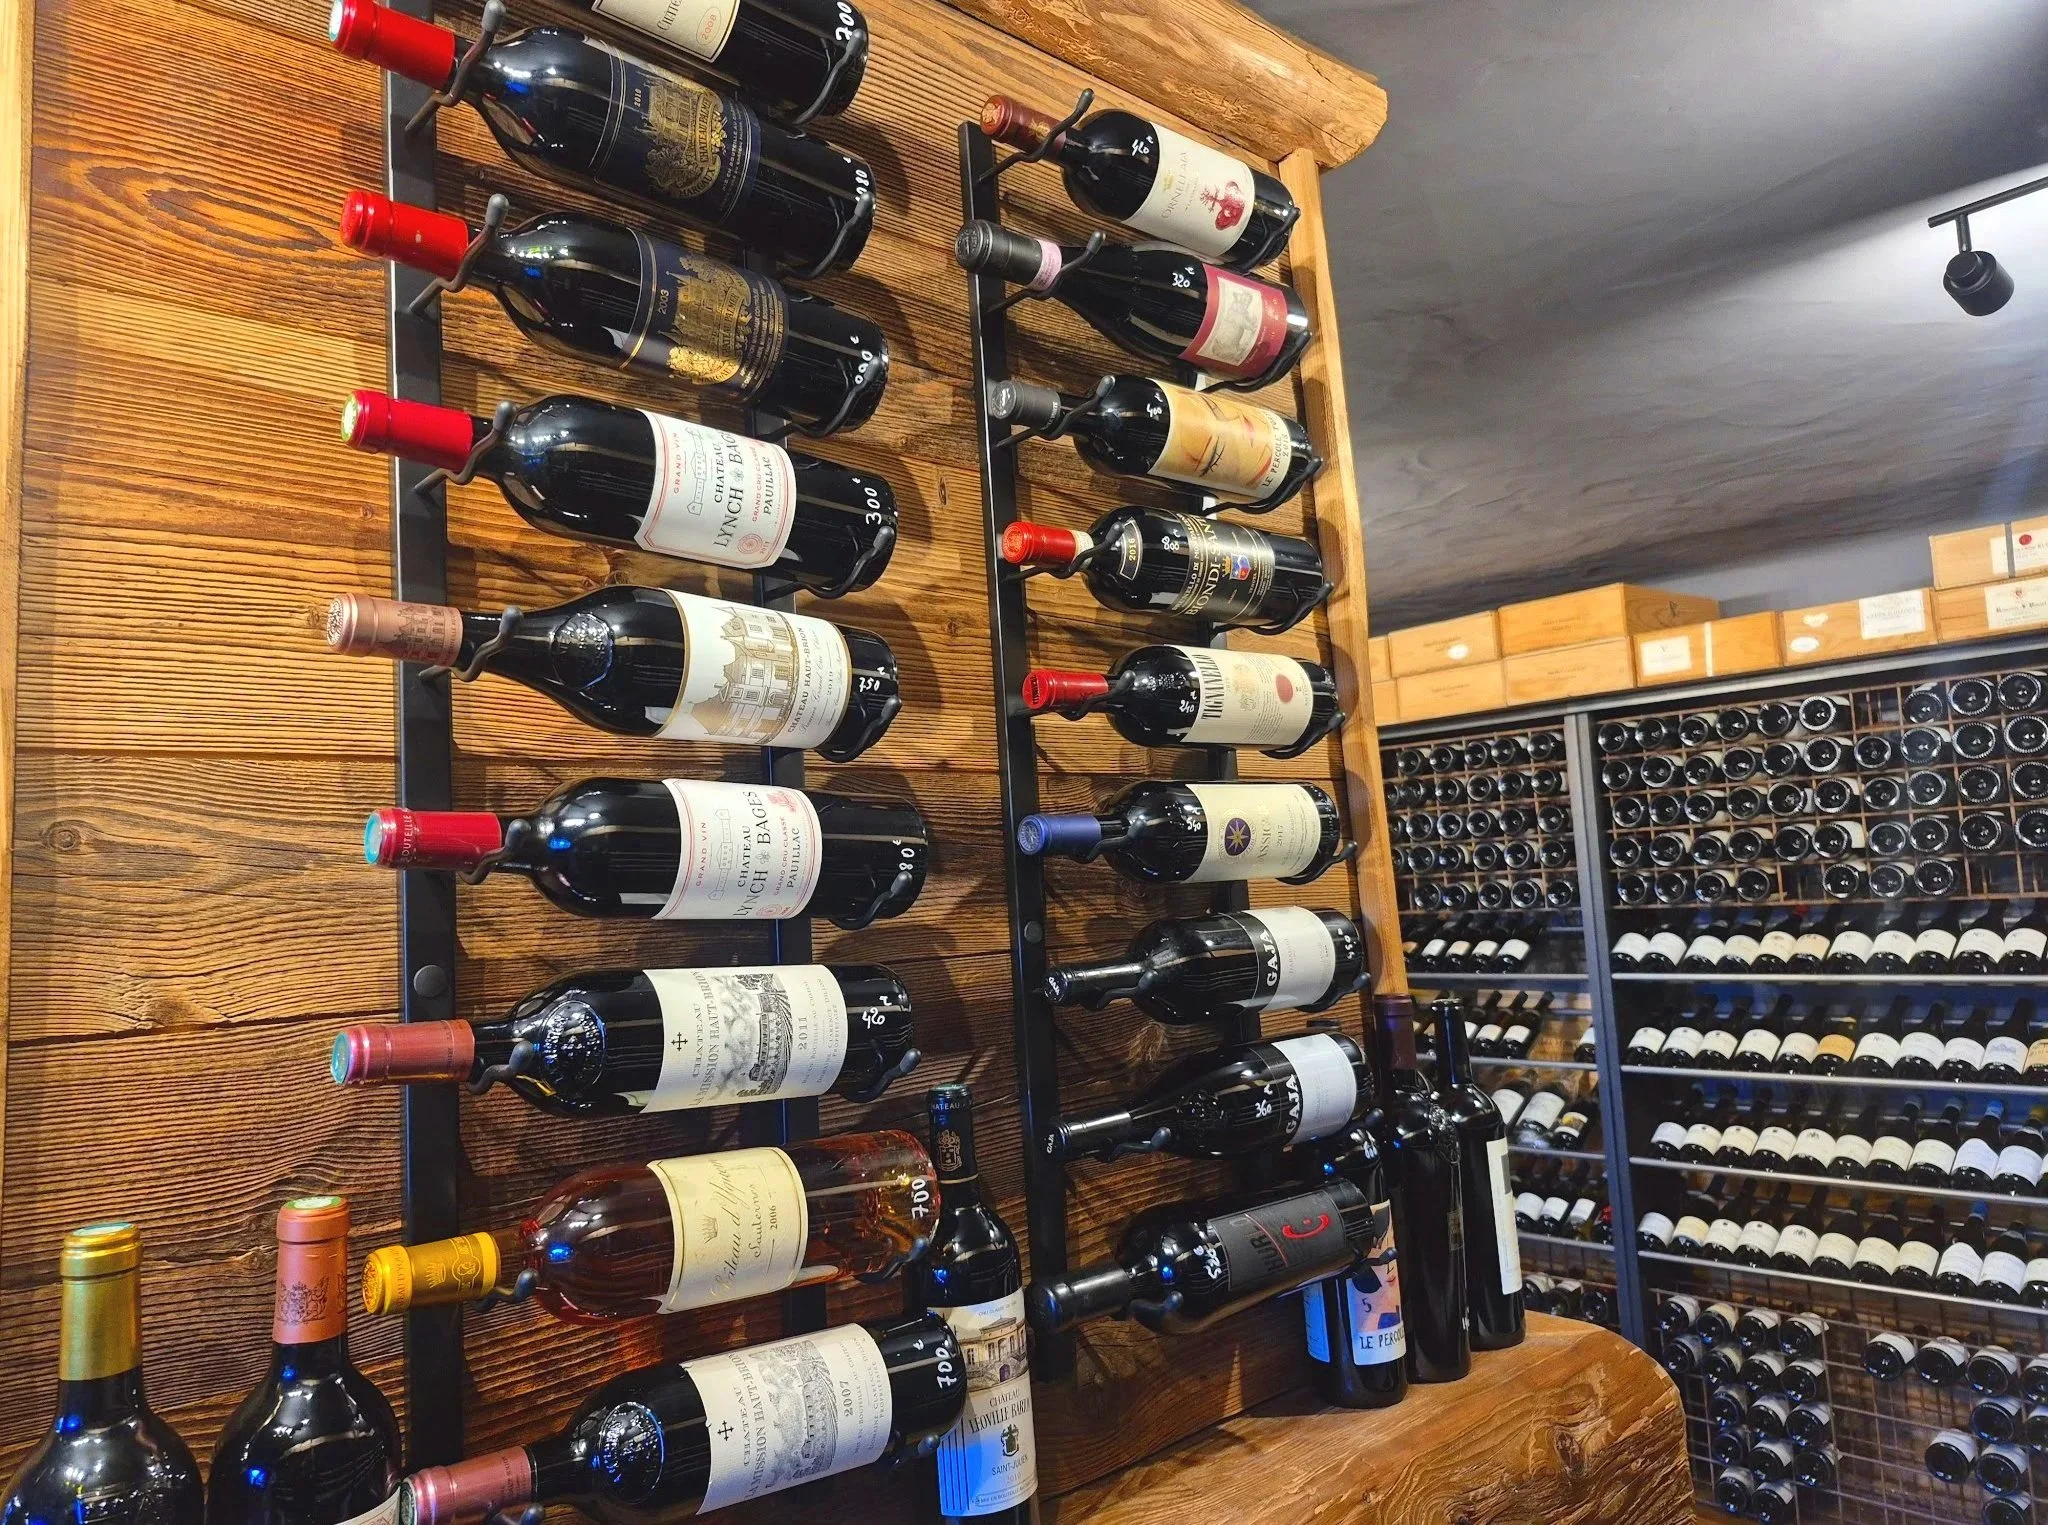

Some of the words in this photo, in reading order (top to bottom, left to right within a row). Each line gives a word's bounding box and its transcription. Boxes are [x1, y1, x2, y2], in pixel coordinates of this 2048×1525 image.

[835, 1, 855, 40] 700
[1172, 272, 1191, 288] 320
[658, 288, 670, 315] 2003
[1146, 403, 1163, 418] 400
[712, 443, 725, 504] CHATEAU
[762, 456, 775, 516] PAUILLAC
[713, 486, 744, 548] LYNCH
[864, 487, 882, 525] 300
[1128, 537, 1136, 562] 2016
[797, 626, 812, 686] HAUT-BRION
[859, 676, 880, 693] 750
[1191, 654, 1225, 720] TIGNANELLO
[787, 691, 809, 733] CHATEAU
[1179, 699, 1195, 714] 240
[743, 791, 771, 845] BAGES
[1186, 817, 1202, 832] 540
[695, 847, 707, 888] GRAND
[737, 825, 751, 888] CHATEAU
[786, 827, 801, 889] PAUILLAC
[733, 870, 768, 916] LYNCH
[774, 869, 786, 896] GRAND
[1260, 929, 1279, 987] GAJA
[692, 1002, 704, 1078] CHATEAU
[798, 1017, 808, 1051] 2011
[1254, 1099, 1272, 1118] 360
[1285, 1074, 1300, 1135] GAJA
[769, 1205, 778, 1231] 2006
[911, 1178, 930, 1219] 700
[749, 1183, 762, 1259] Sauternes
[1359, 1336, 1374, 1350] LE
[728, 1352, 766, 1424] HAUT-BRION
[936, 1346, 957, 1390] 700
[839, 1379, 854, 1418] 2007
[732, 1385, 751, 1467] CHATEAU
